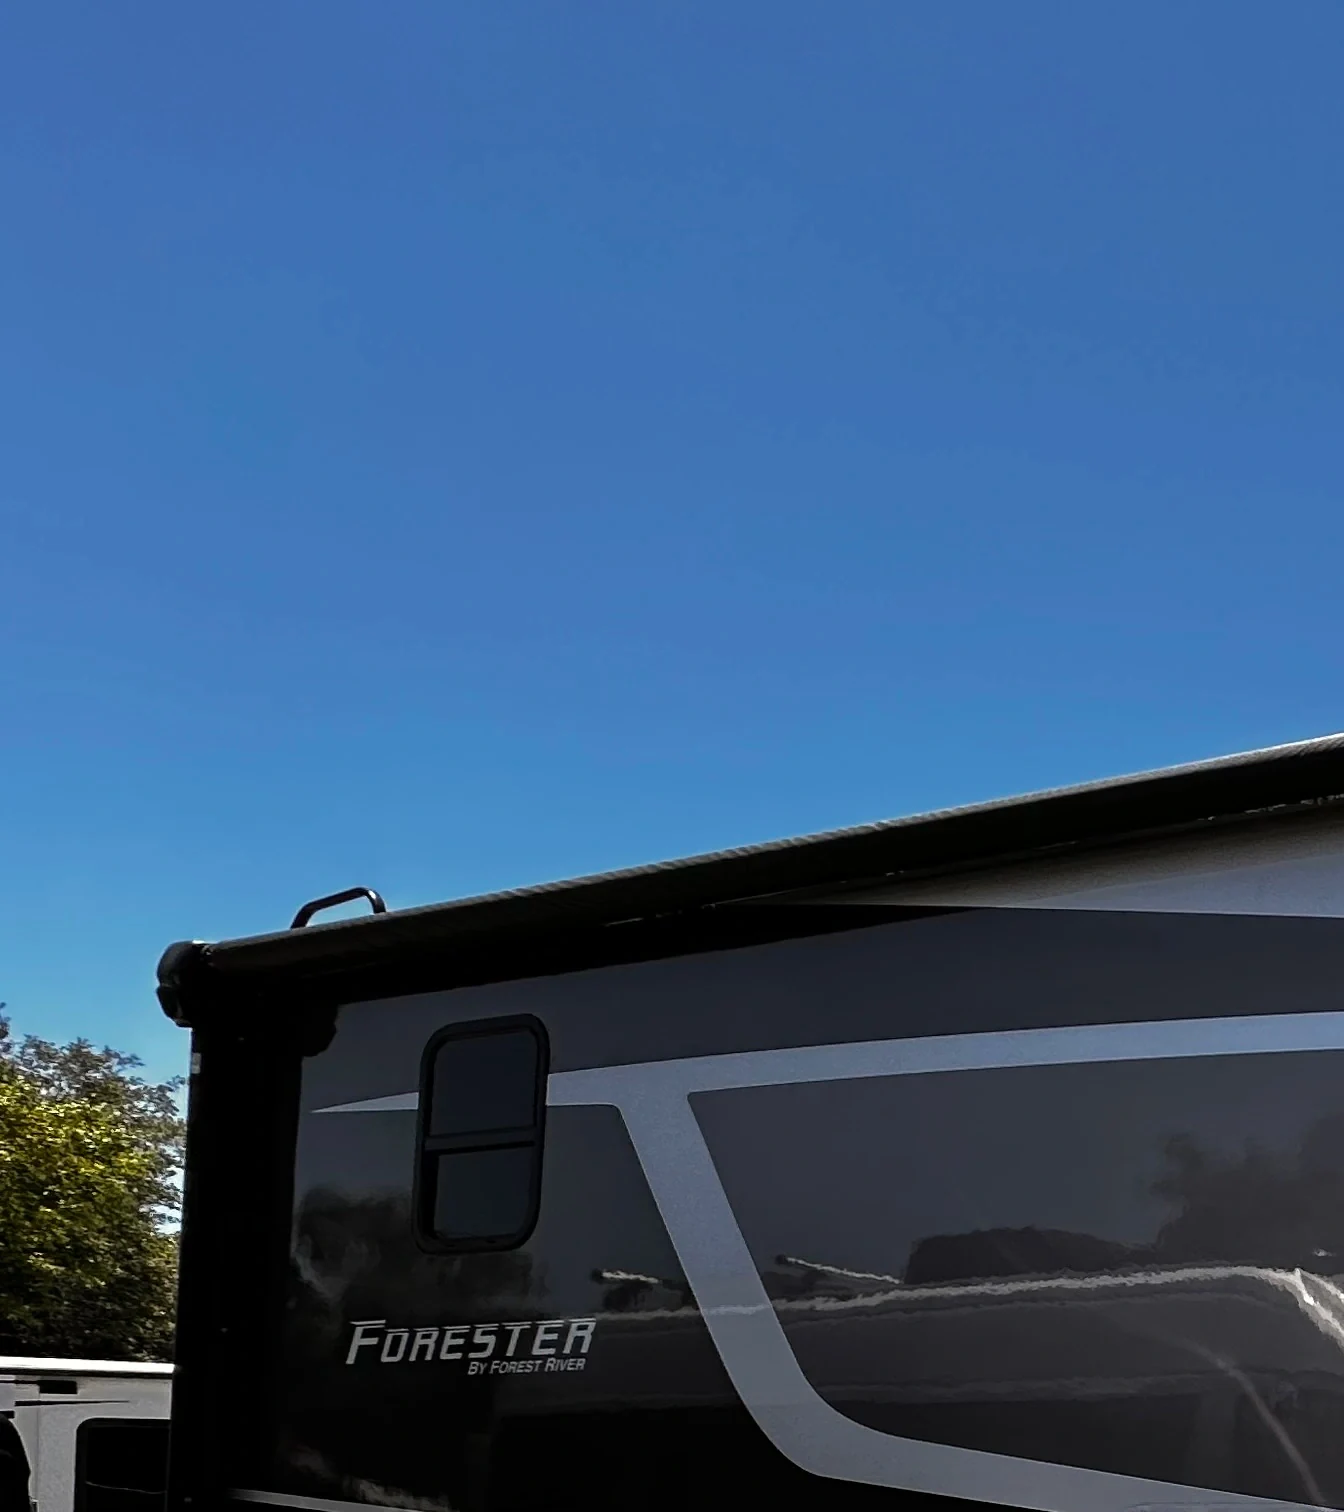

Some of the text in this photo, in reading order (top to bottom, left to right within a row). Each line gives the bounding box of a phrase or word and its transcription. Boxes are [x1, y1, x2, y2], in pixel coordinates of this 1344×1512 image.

[345, 1317, 597, 1365] FORESTER
[467, 1357, 587, 1375] BY FOREST RIVER
